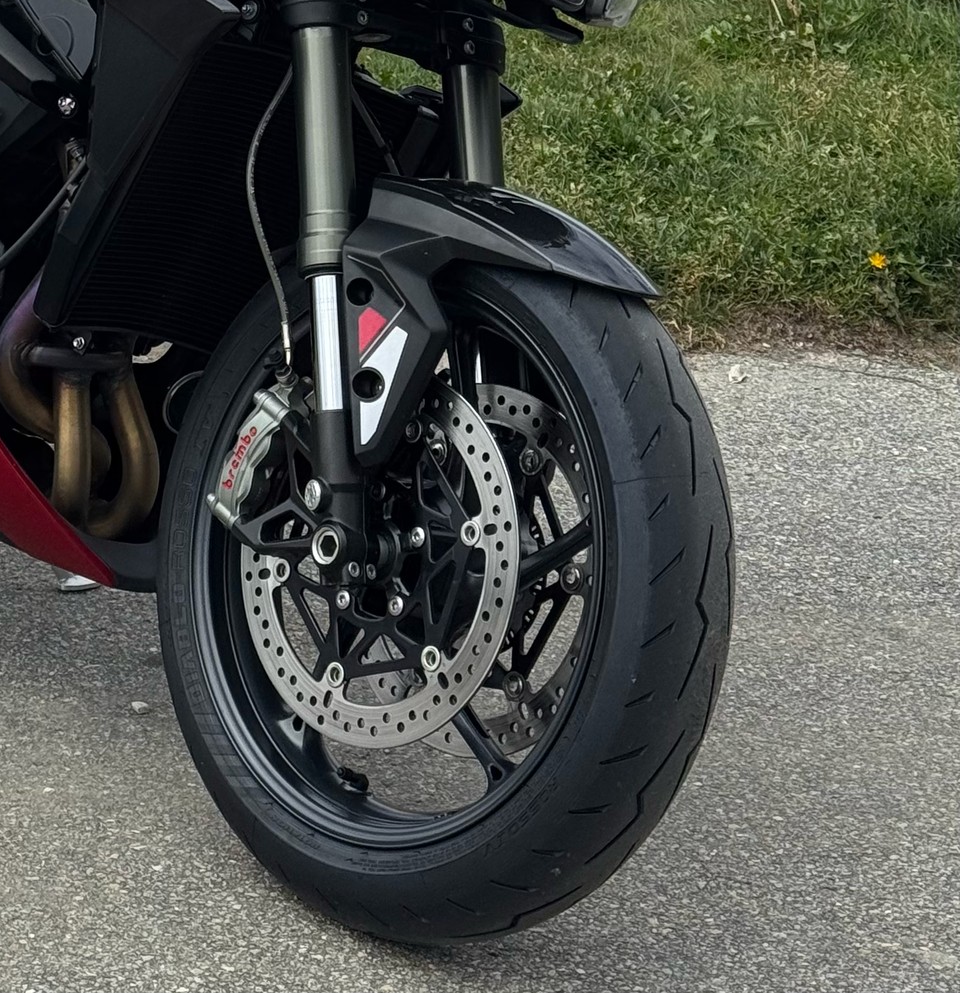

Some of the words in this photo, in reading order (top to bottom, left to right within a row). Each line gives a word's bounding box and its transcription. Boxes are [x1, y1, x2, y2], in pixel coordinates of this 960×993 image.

[221, 426, 258, 490] brembo
[171, 467, 197, 570] ROSSO
[171, 584, 205, 704] DIABLO
